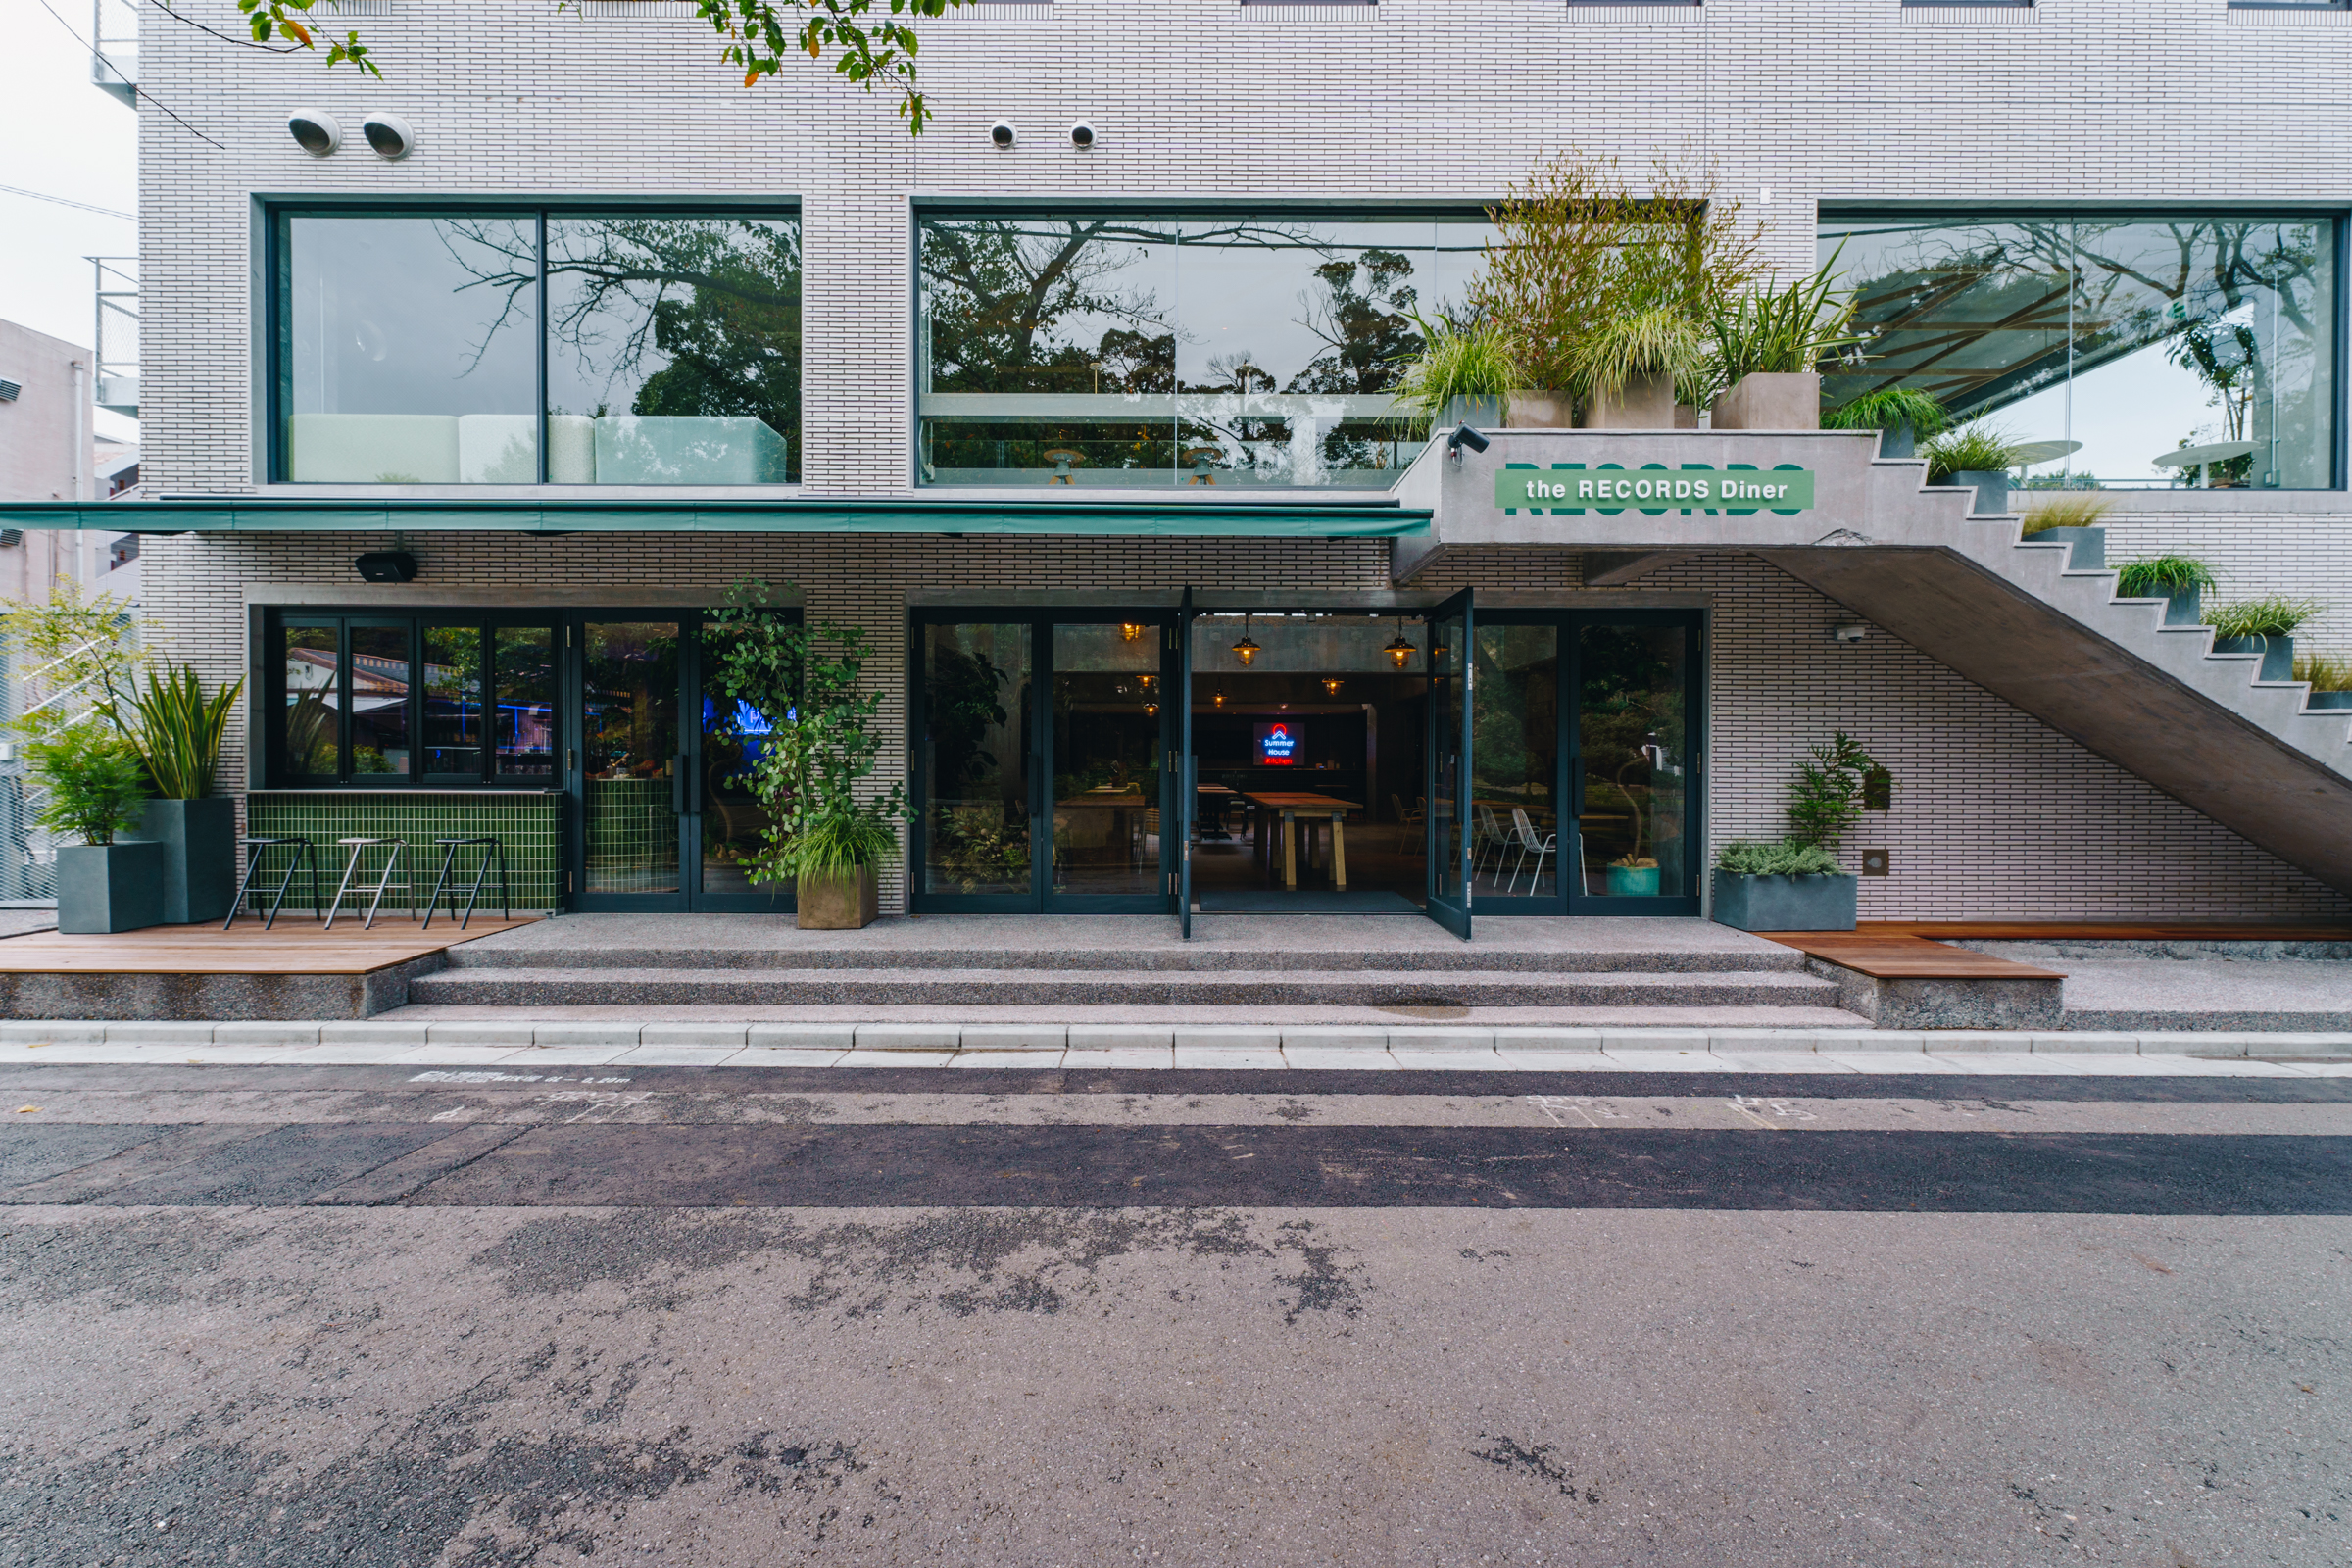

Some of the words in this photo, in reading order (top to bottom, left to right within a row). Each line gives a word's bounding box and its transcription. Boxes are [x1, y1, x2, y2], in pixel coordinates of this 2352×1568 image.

[1526, 480, 1566, 499] the
[1578, 479, 1710, 500] RECORDS
[1721, 480, 1788, 500] Diner
